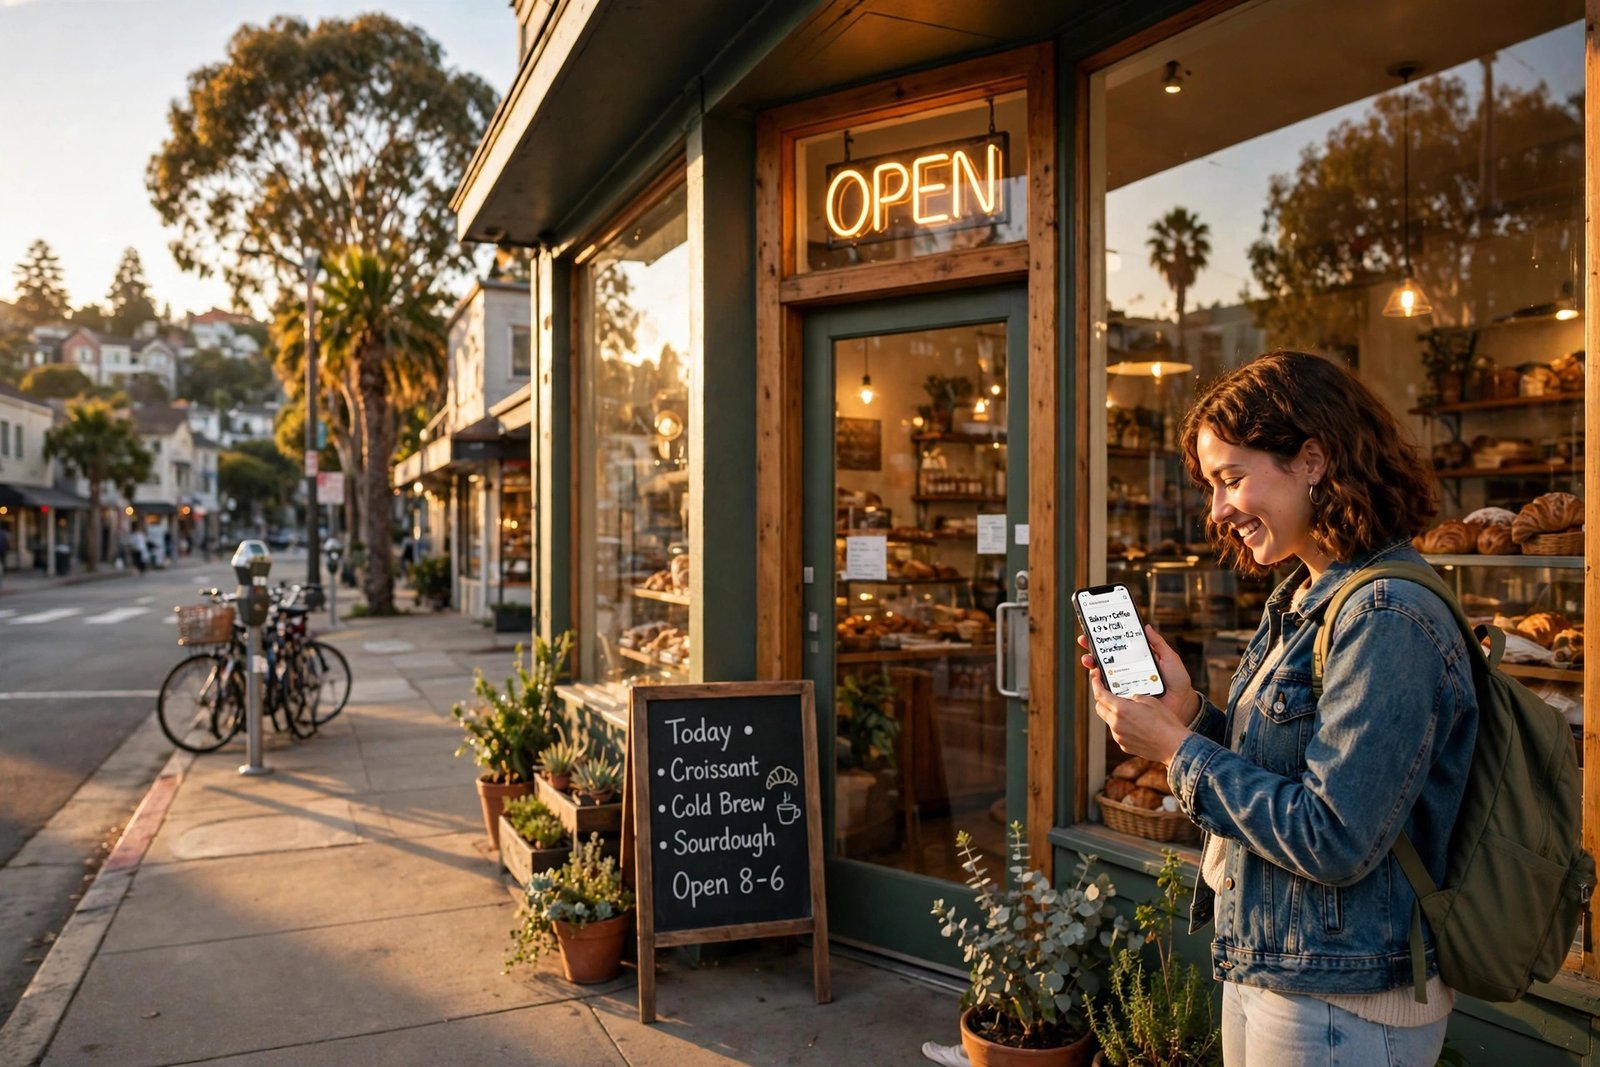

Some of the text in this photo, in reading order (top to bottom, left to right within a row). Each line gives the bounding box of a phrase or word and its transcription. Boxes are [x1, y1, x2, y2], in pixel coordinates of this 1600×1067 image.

[826, 144, 1000, 237] OPEN
[664, 717, 732, 752] Today
[670, 755, 760, 783] Croissant
[671, 791, 765, 818] Cold Brew
[673, 823, 776, 858] Sourdough
[672, 865, 785, 908] Open 8-6
